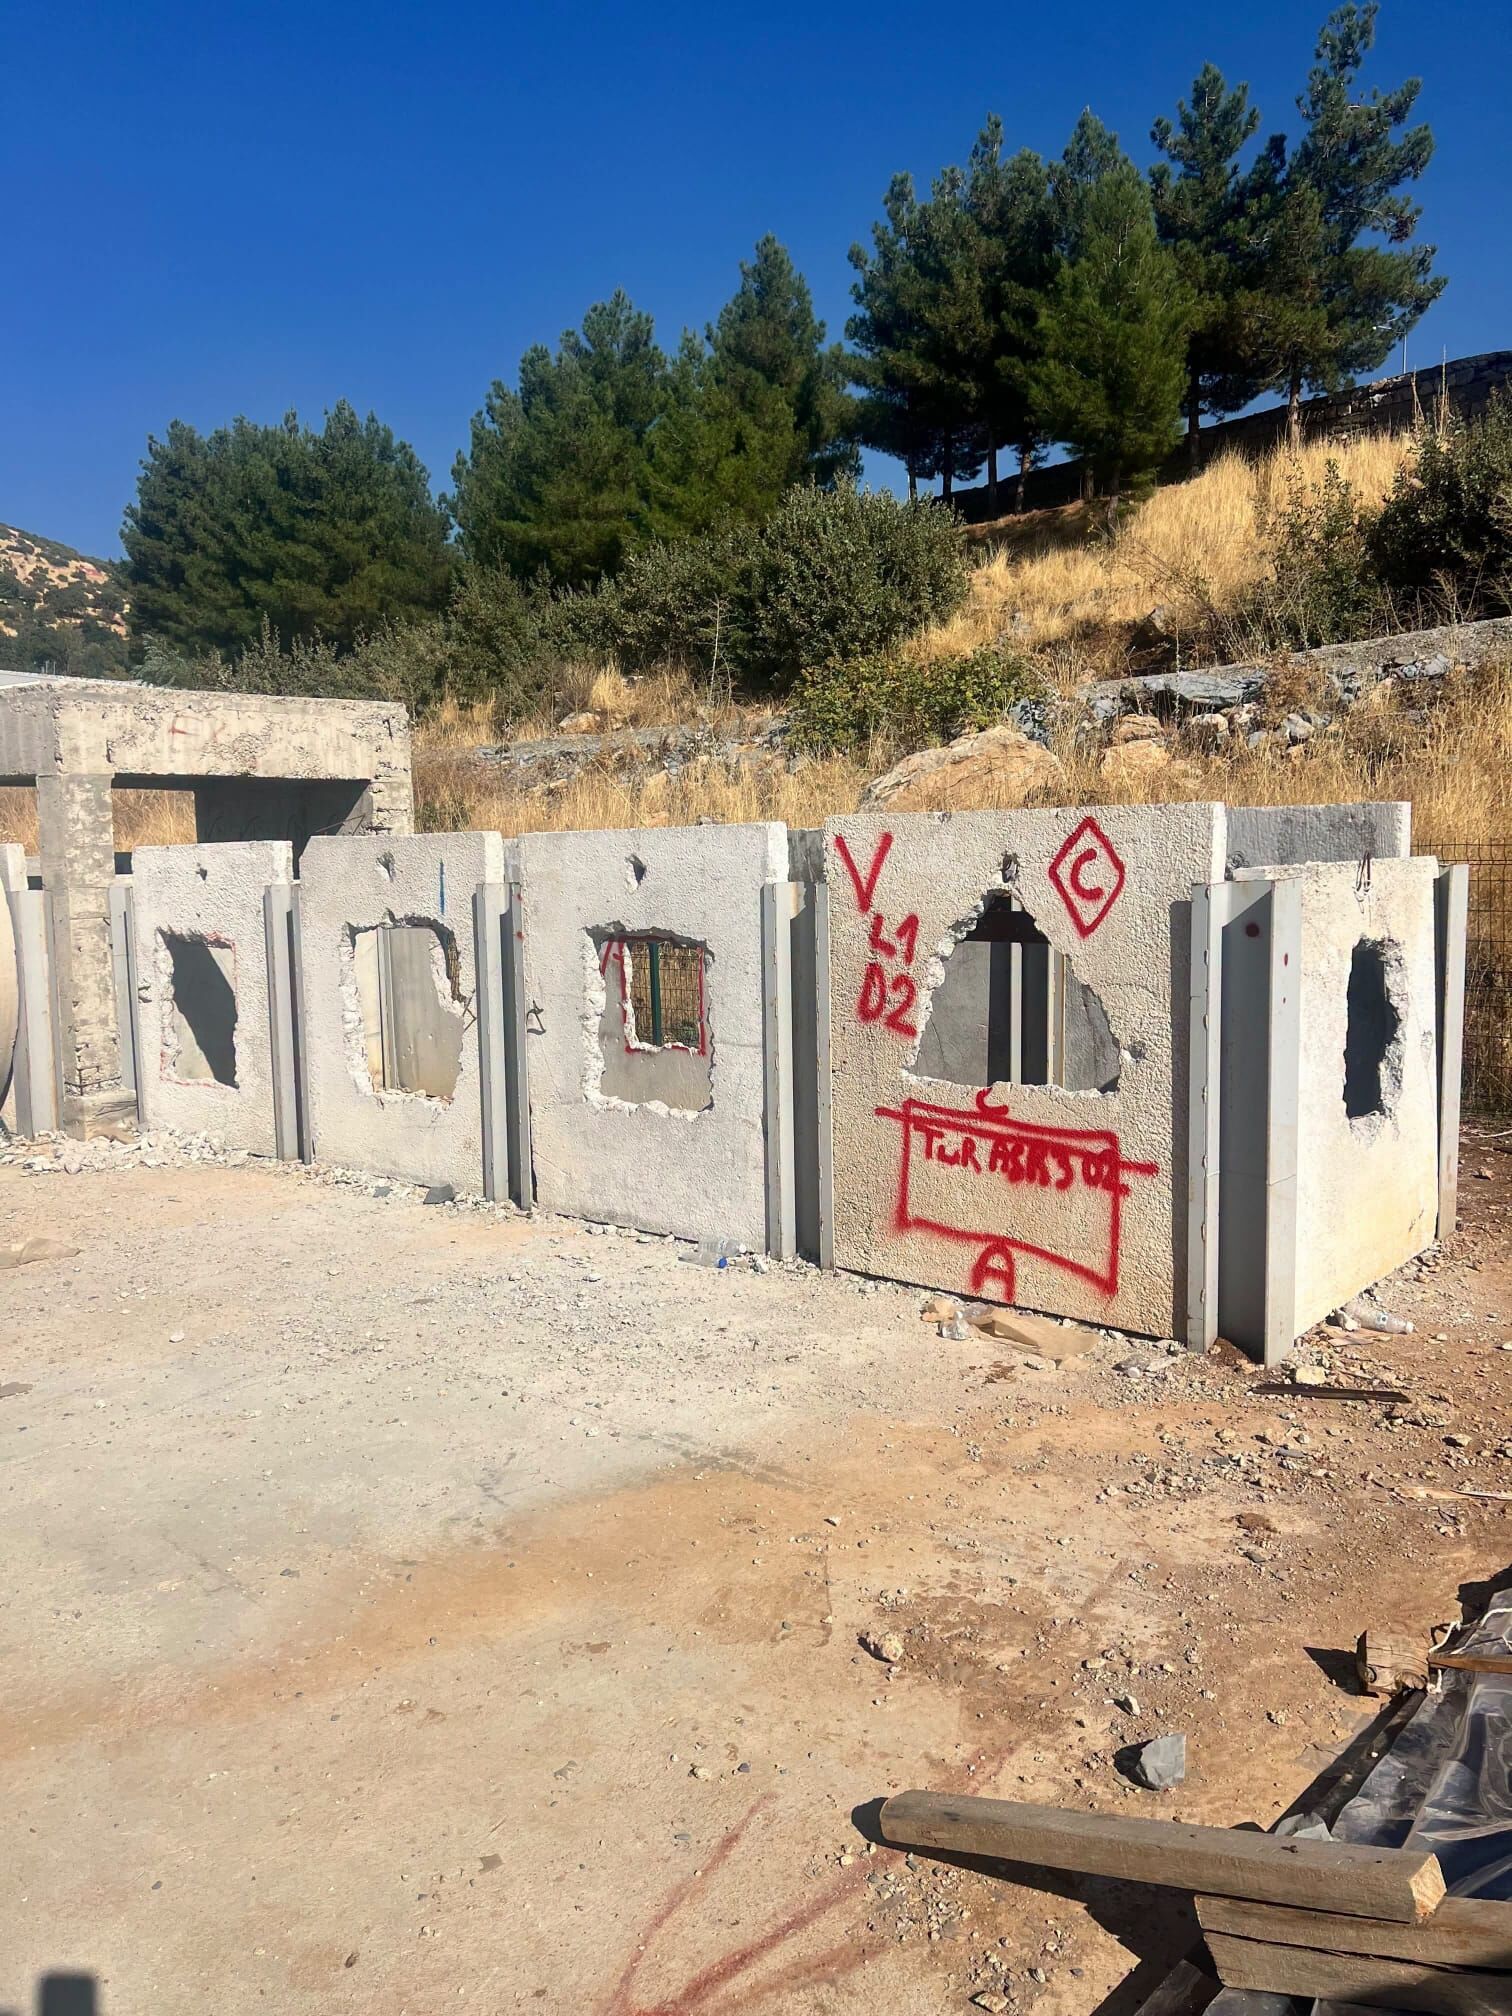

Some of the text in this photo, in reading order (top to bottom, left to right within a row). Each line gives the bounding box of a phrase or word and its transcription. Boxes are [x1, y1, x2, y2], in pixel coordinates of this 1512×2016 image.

[834, 832, 893, 912] V
[1070, 847, 1105, 901] C
[970, 1239, 1015, 1303] A
